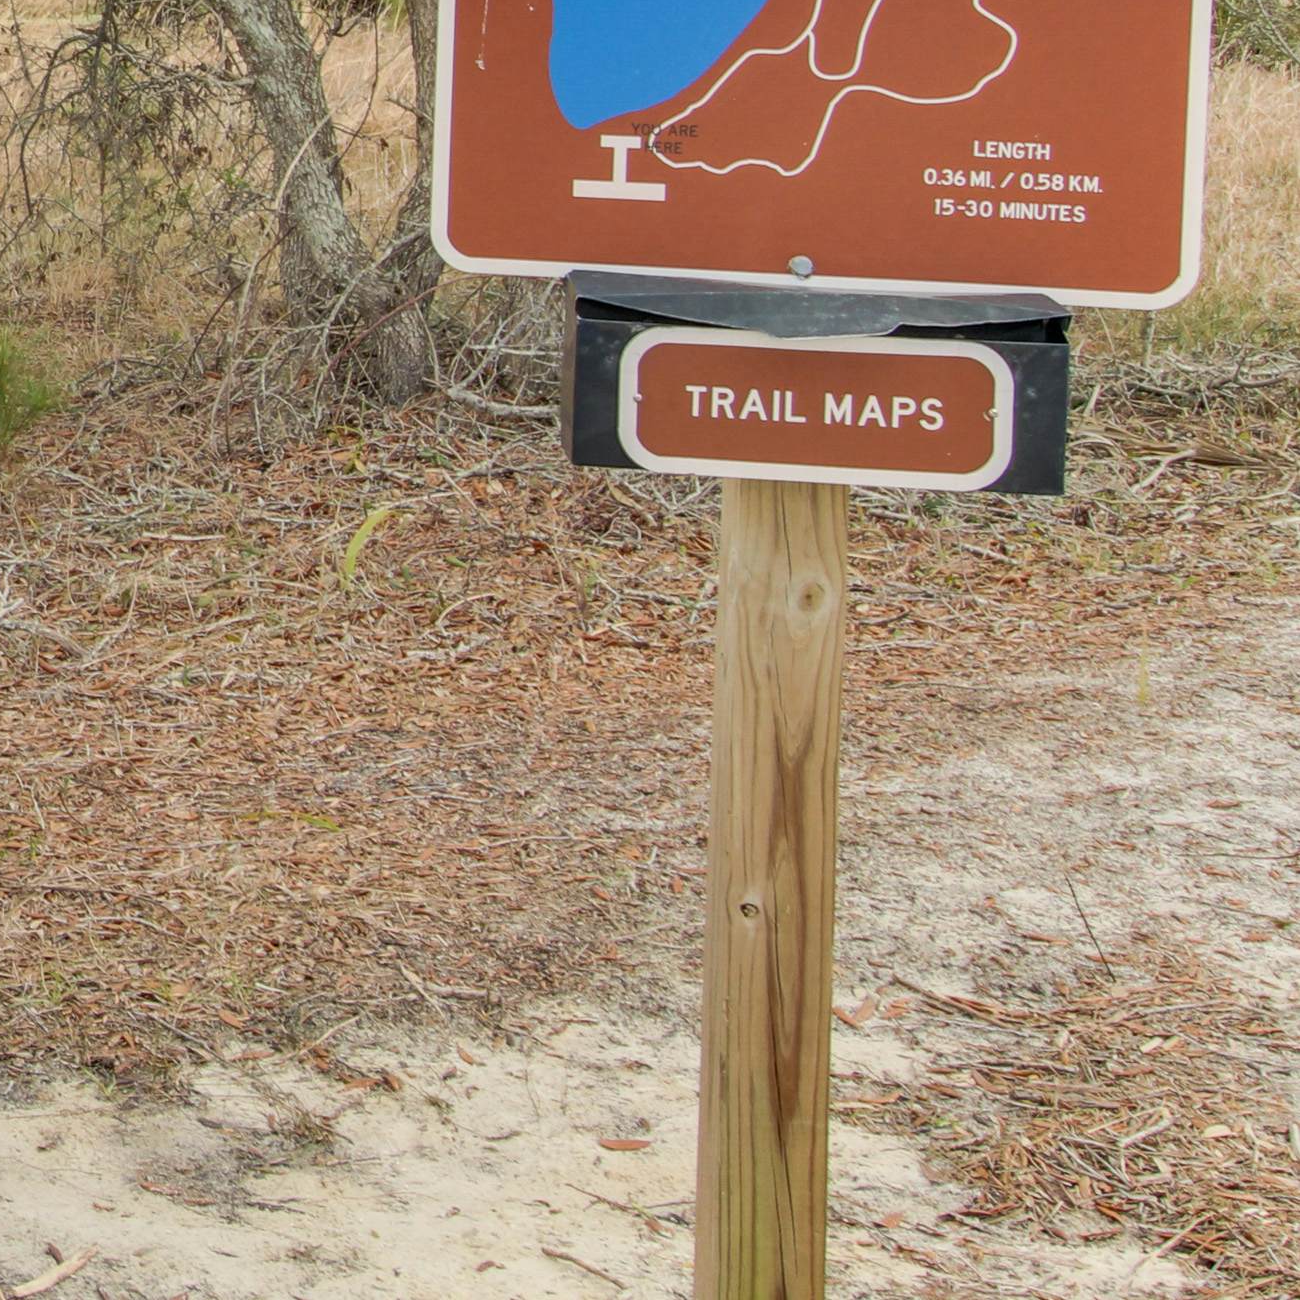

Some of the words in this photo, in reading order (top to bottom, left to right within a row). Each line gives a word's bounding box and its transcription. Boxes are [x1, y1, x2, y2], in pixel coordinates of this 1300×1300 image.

[667, 123, 699, 138] ARE
[972, 139, 1051, 161] LENGTH
[923, 167, 967, 188] 0.36
[969, 170, 996, 189] MI.
[999, 172, 1015, 189] /
[1019, 172, 1065, 192] 0.58
[1067, 175, 1104, 193] KM.
[933, 198, 994, 218] 15-30
[999, 201, 1087, 223] MINUTES
[685, 384, 807, 424] TRAIL
[823, 392, 945, 432] MAPS
